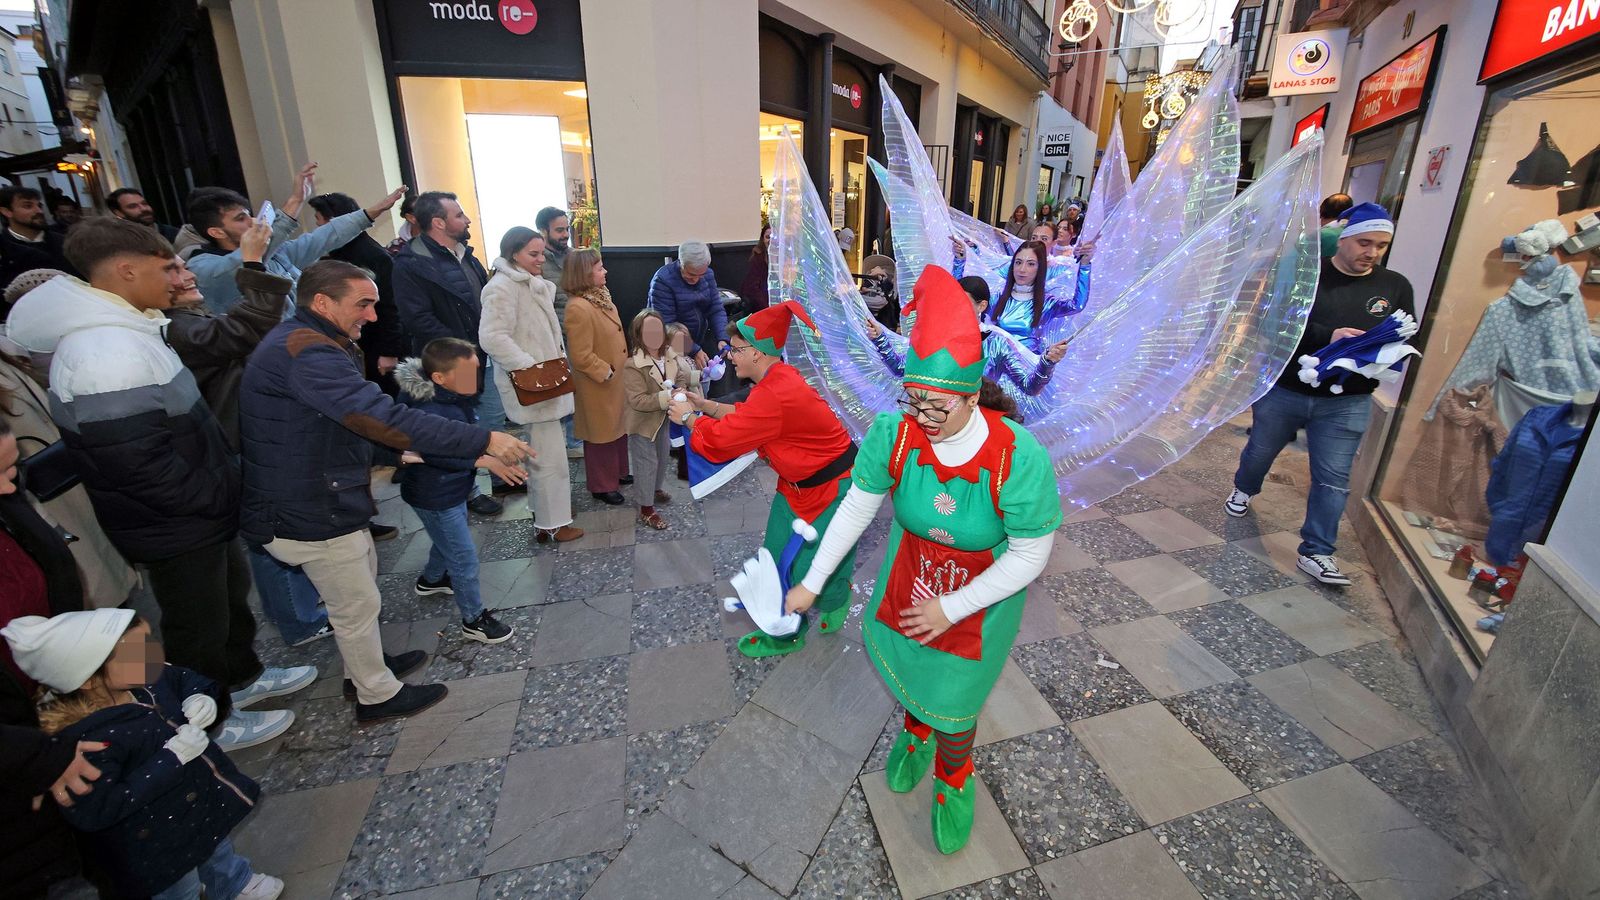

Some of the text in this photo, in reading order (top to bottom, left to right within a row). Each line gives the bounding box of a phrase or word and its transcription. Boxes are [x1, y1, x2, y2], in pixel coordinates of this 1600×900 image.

[429, 0, 494, 21] moda
[1273, 79, 1307, 89] LANAS
[1047, 133, 1071, 142] NICE
[1045, 145, 1068, 155] GIRL
